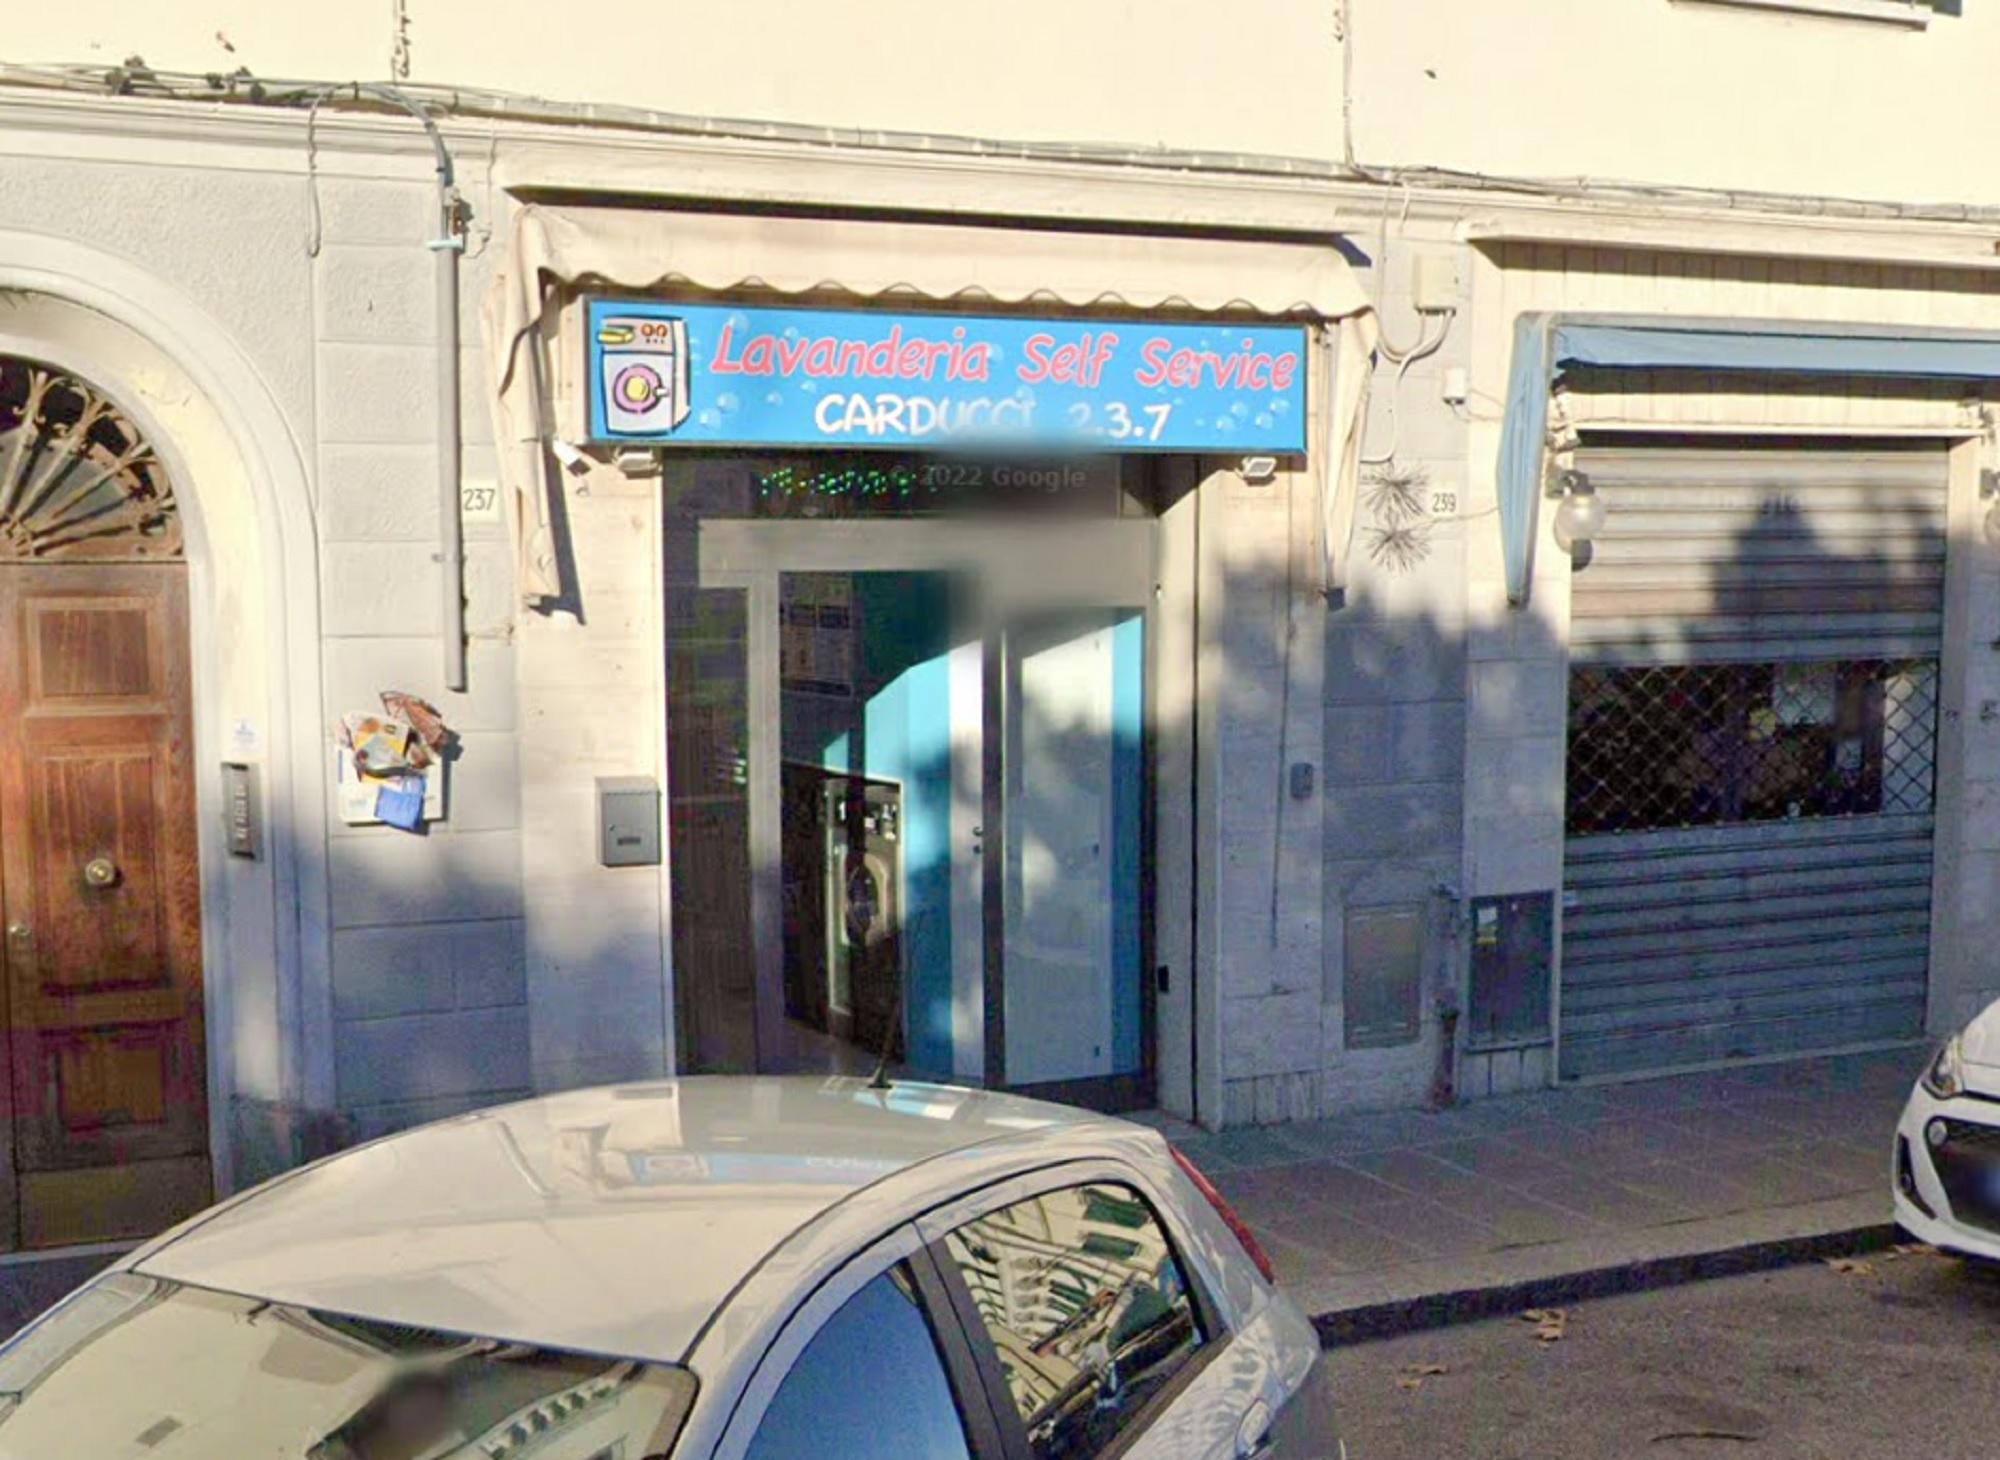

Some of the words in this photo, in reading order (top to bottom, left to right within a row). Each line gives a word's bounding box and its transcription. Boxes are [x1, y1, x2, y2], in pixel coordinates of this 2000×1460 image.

[711, 324, 990, 381] Lavanderia
[1017, 331, 1119, 388] Self
[1134, 337, 1298, 390] Service
[463, 488, 495, 511] 237
[1432, 492, 1456, 512] 239
